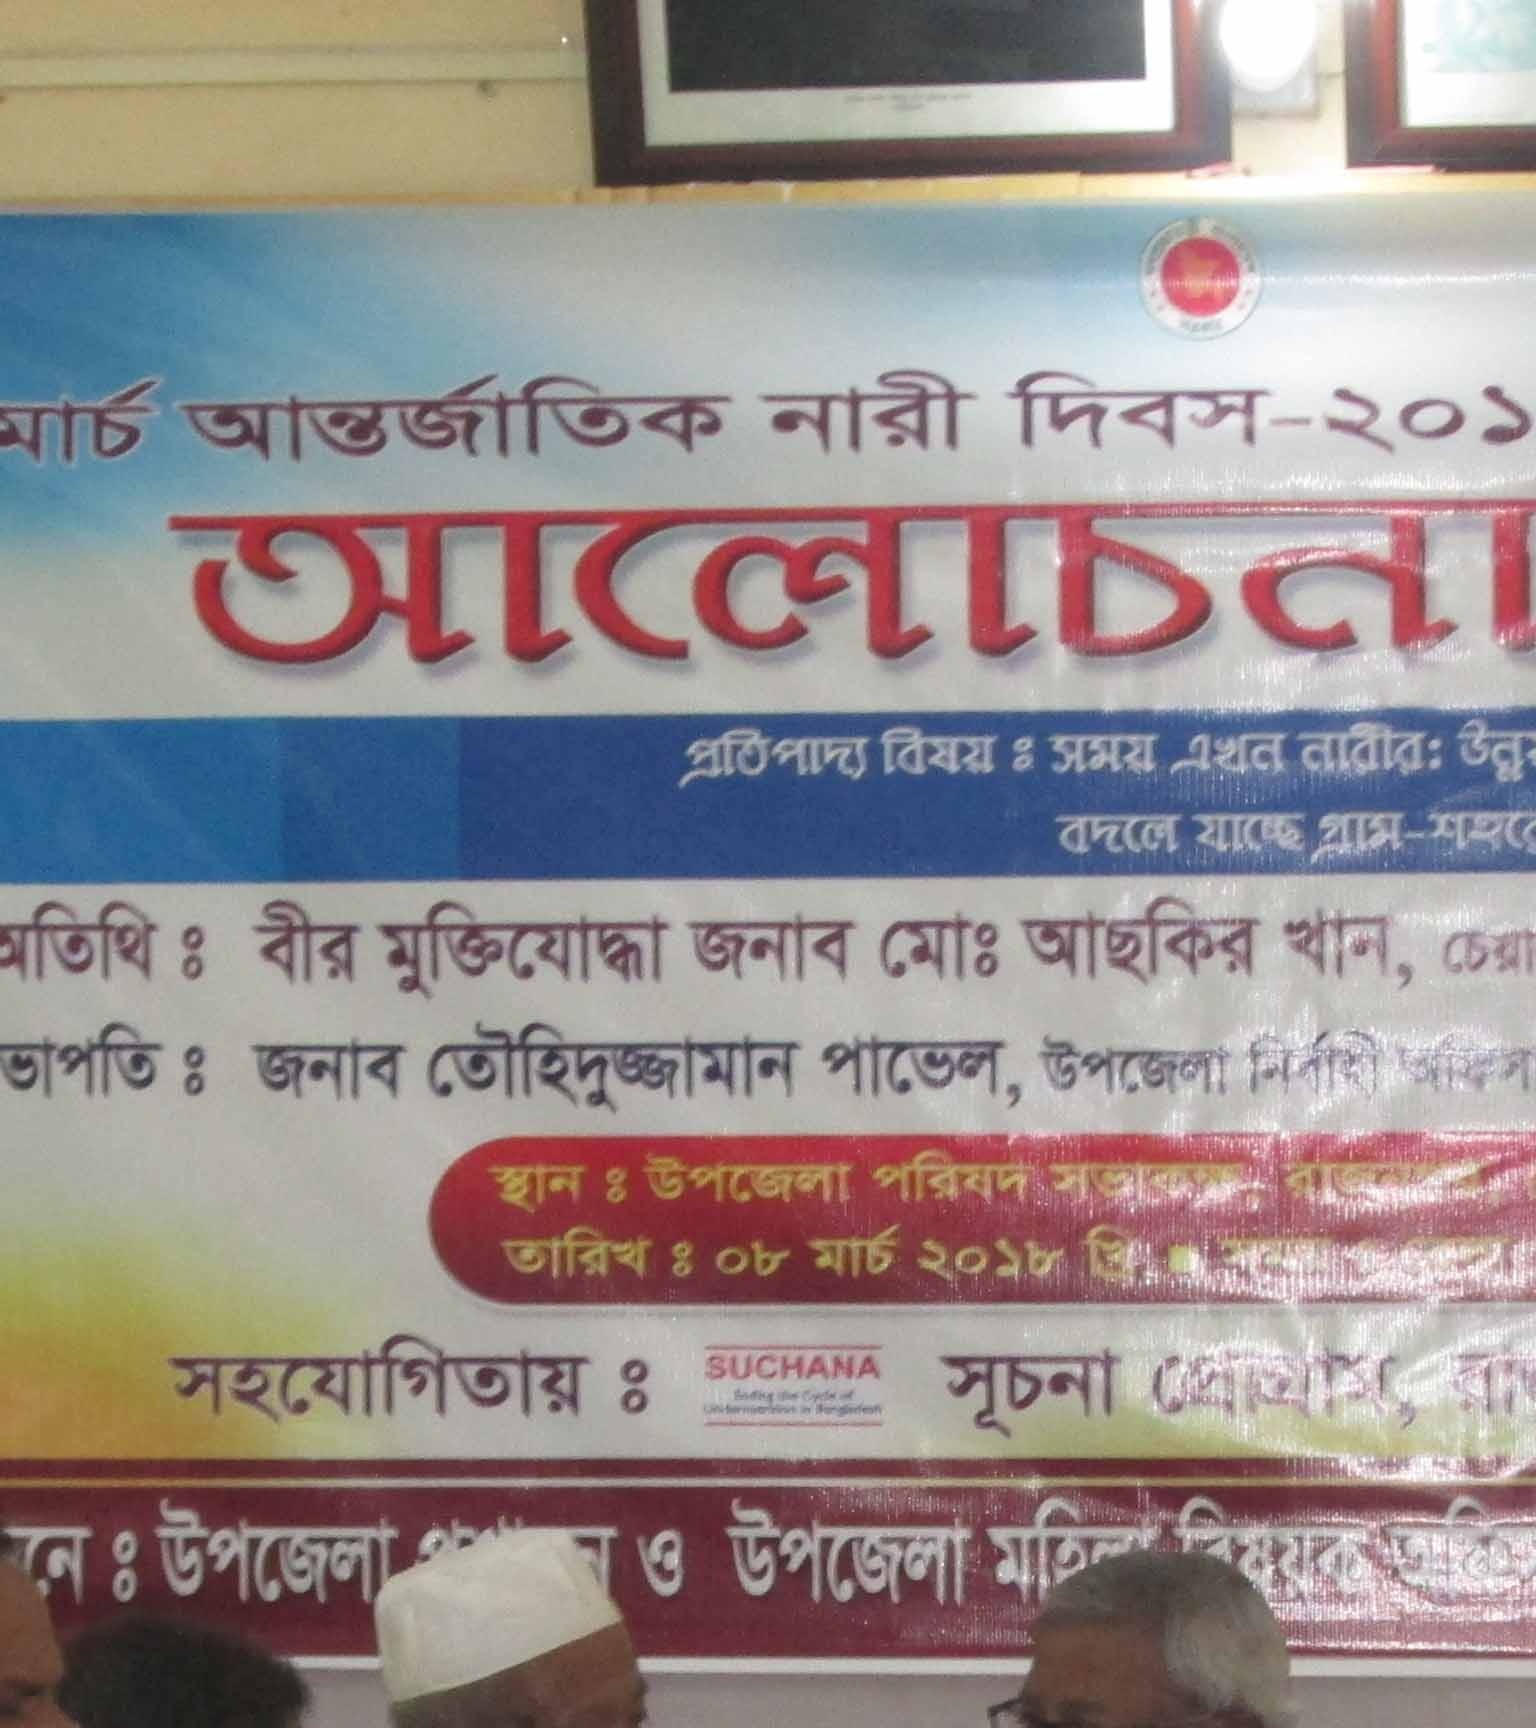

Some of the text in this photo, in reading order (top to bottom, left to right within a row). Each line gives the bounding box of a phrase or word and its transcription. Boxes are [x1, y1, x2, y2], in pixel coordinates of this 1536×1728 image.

[178, 372, 733, 463] আন্তর্জাতিক
[762, 369, 979, 453] নারী
[678, 727, 869, 789] প্রতিপাদ্য
[881, 725, 999, 776] বিষয়
[1048, 732, 1160, 775] সময়
[1170, 732, 1285, 776] এখন
[1056, 812, 1184, 854] বদলে
[1195, 812, 1306, 854] যাচ্ছে
[253, 899, 361, 982] বীর
[375, 899, 669, 999] মুক্তিযোদ্ধা
[686, 912, 856, 981] জনাব
[1020, 896, 1262, 984] আছকির
[253, 1034, 408, 1098] জনাব
[427, 1020, 801, 1111] তৌহিদুজ্জামান
[820, 1034, 1023, 1108] পাভেল,
[1038, 1034, 1229, 1096] উপজেলা
[487, 1158, 586, 1216] স্থান
[642, 1151, 854, 1205] উপজেলা
[872, 1147, 1030, 1204] পরিষদ
[501, 1225, 655, 1279] তারিখ
[715, 1242, 791, 1277] ০৮
[806, 1222, 903, 1278] মার্চ
[920, 1238, 1064, 1282] ২০১৮
[168, 1333, 593, 1424] সহযোগিতায়
[704, 1354, 882, 1380] SUCHANA
[939, 1347, 1123, 1438] সূচনা
[153, 1497, 400, 1605] উপজেলা
[635, 1528, 685, 1598] ও
[724, 1496, 971, 1605] উপজেলা
